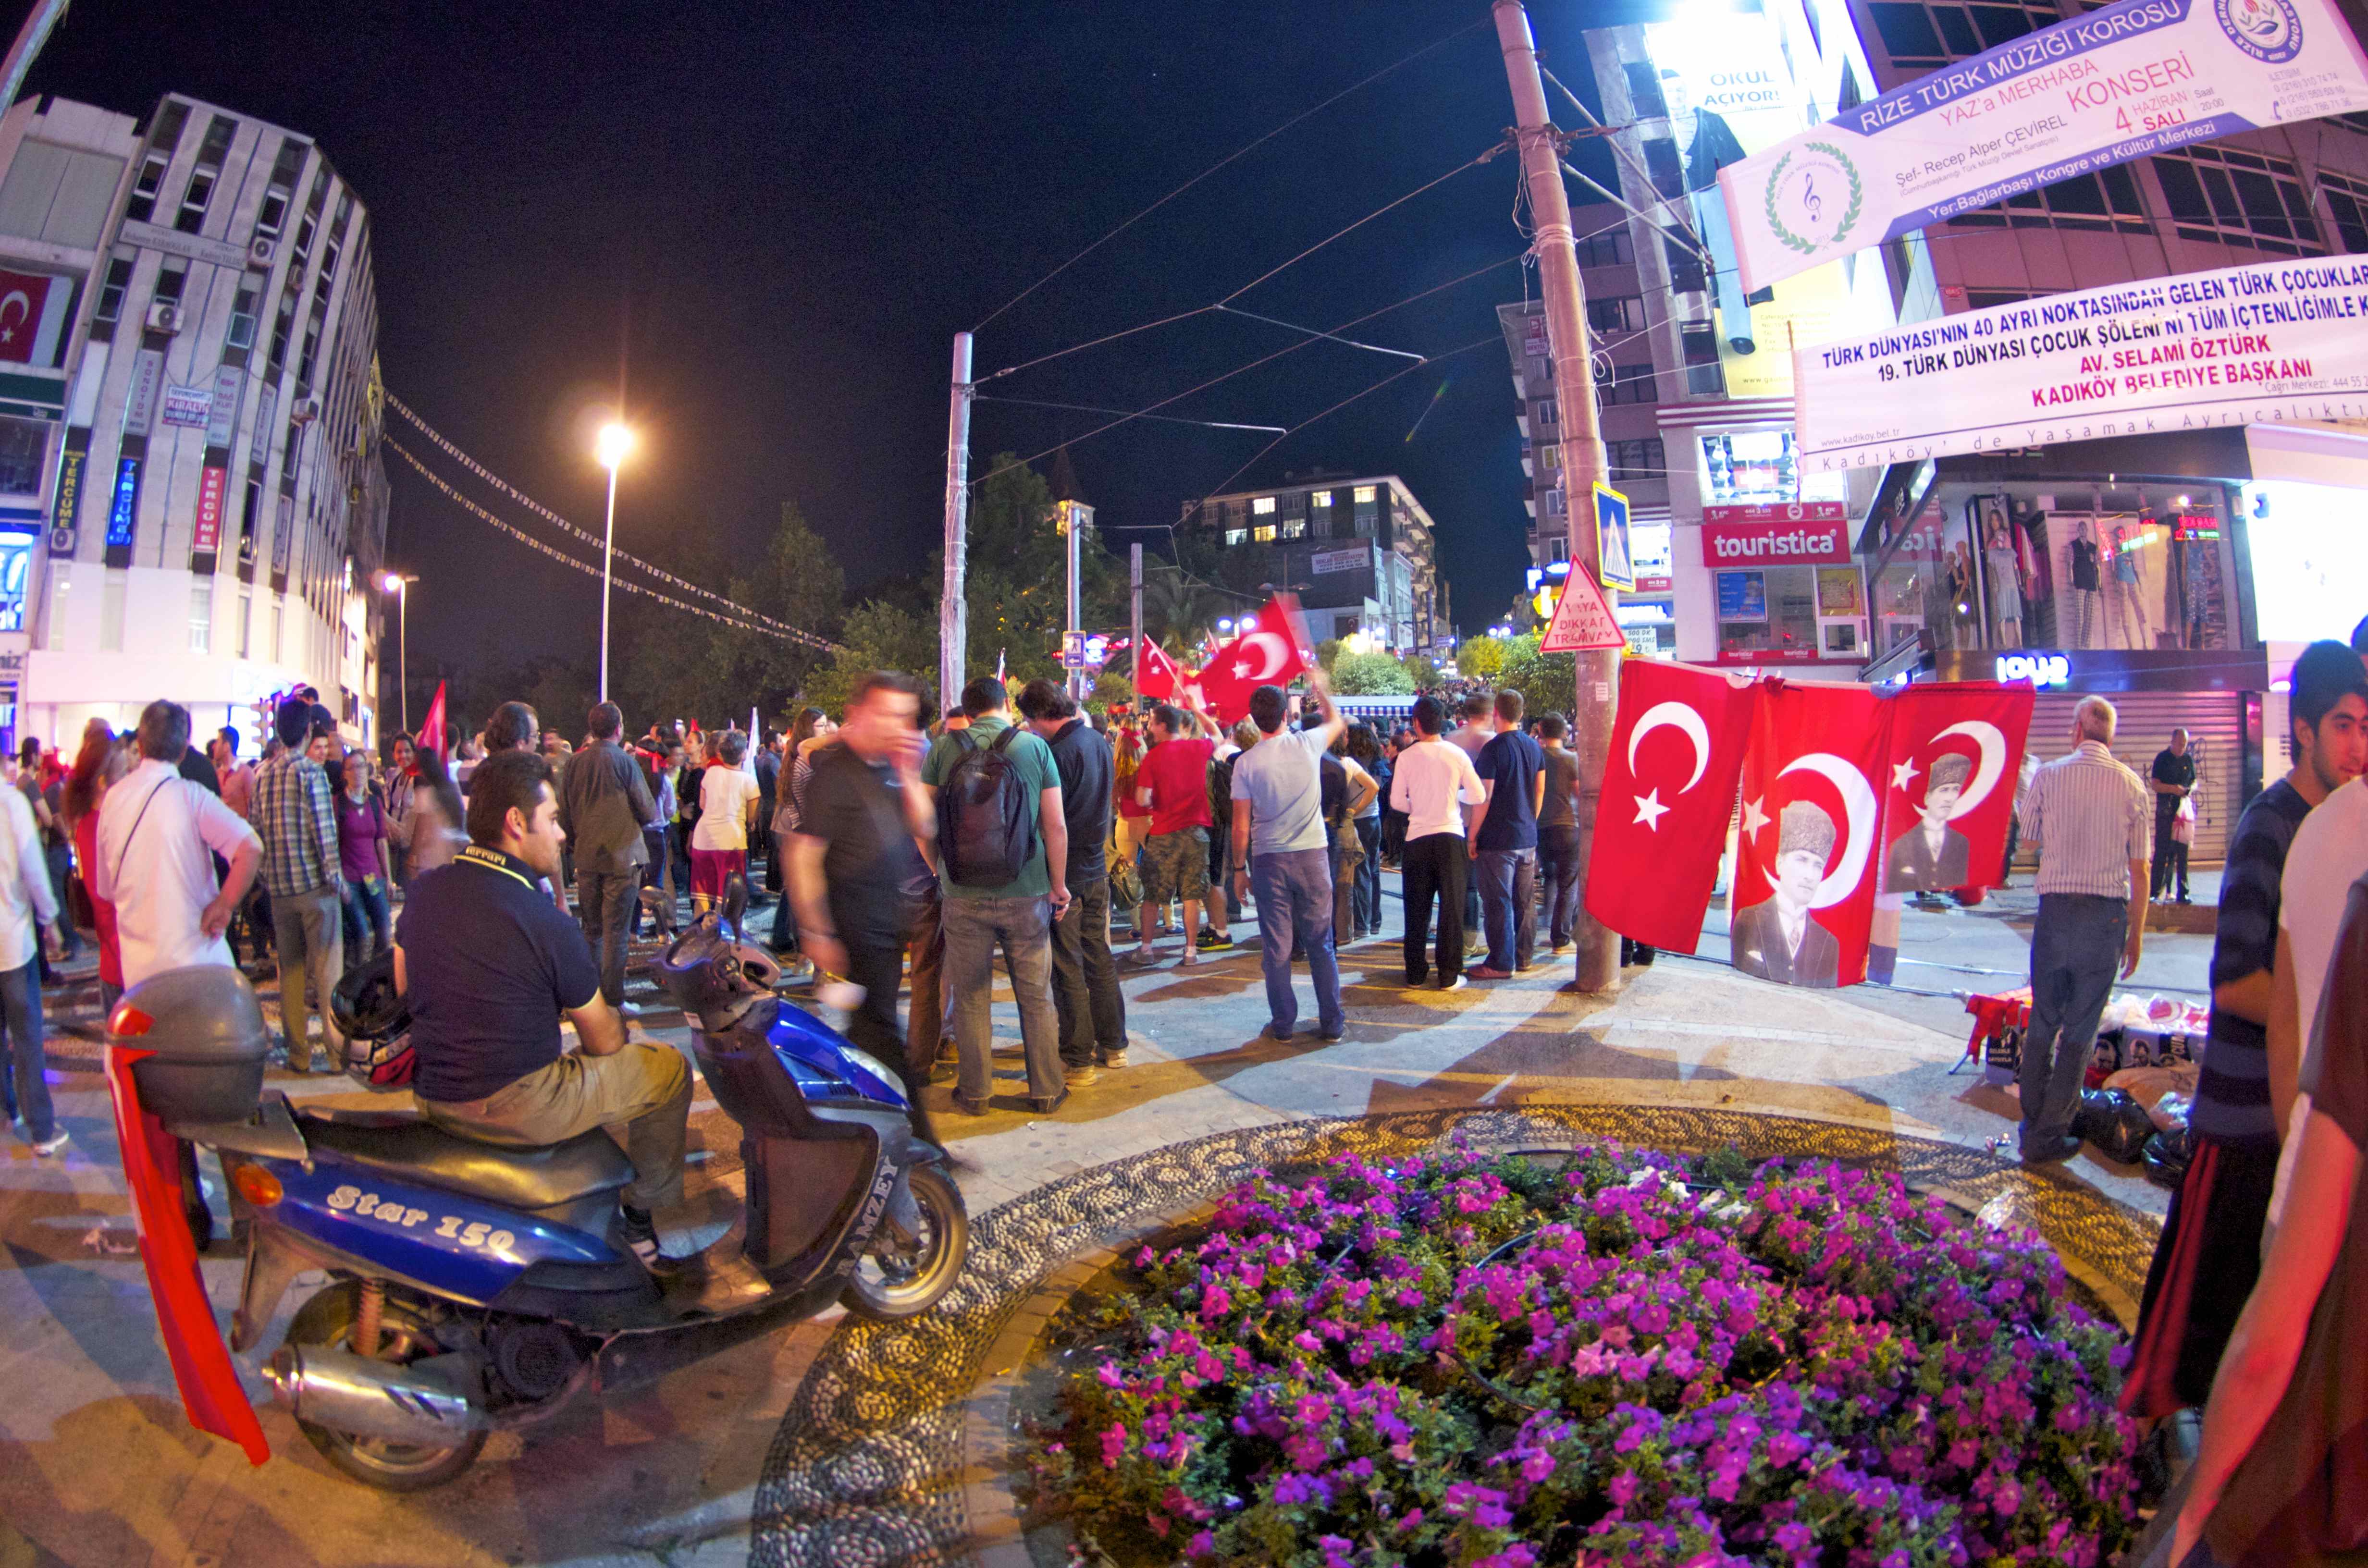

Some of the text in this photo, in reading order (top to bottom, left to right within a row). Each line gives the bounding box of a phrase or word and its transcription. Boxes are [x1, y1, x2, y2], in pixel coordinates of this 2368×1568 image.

[1710, 70, 1775, 86] OKUL
[1860, 0, 2181, 132] RİZE TÜRK MÜZİĞİ KOROSU
[2066, 50, 2195, 113] KONSERİ
[1704, 90, 1780, 107] AÇIYOR!
[1939, 59, 2099, 128] YAZ'a MERHABA
[2132, 88, 2188, 116] HAZİRAN
[2199, 98, 2224, 112] 20:00
[2116, 107, 2186, 135] 4 SALI
[1895, 114, 2068, 187] Şef- Recep Alper ÇEVİREL
[2035, 159, 2090, 184] Kongre
[2091, 152, 2110, 165] ve
[2111, 136, 2156, 159] Kültür
[2158, 121, 2217, 147] Merkezi
[1822, 344, 1865, 368] TÜRK
[1868, 322, 1968, 359] DÜNYASI'NIN
[1973, 317, 1994, 337] 40
[1999, 308, 2038, 333] AYRI
[2169, 278, 2226, 305] GELEN
[2228, 270, 2278, 297] TÜRK
[1878, 364, 1899, 382] 19.
[1903, 352, 1949, 377] TÜRK
[1953, 342, 2026, 369] DÜNYASI
[2030, 328, 2092, 356] ÇOCUK
[2187, 306, 2228, 332] TÜM
[2230, 294, 2356, 330] İÇTENLİĞİMLE
[2080, 333, 2271, 374] AV. SELAMİ ÖZTÜRK
[2032, 358, 2313, 407] KADIKÖY BELEDİYE BAŞKANI
[2265, 380, 2288, 394] Çağrı
[2291, 379, 2330, 390] Merkezi:
[2333, 377, 2348, 386] 444
[2351, 375, 2362, 387] 55
[1821, 427, 1900, 447] www.kadikoy.bel.tr
[1714, 530, 1834, 557] touristica
[327, 1185, 516, 1251] Star 150
[834, 1154, 898, 1276] RAMZEY
